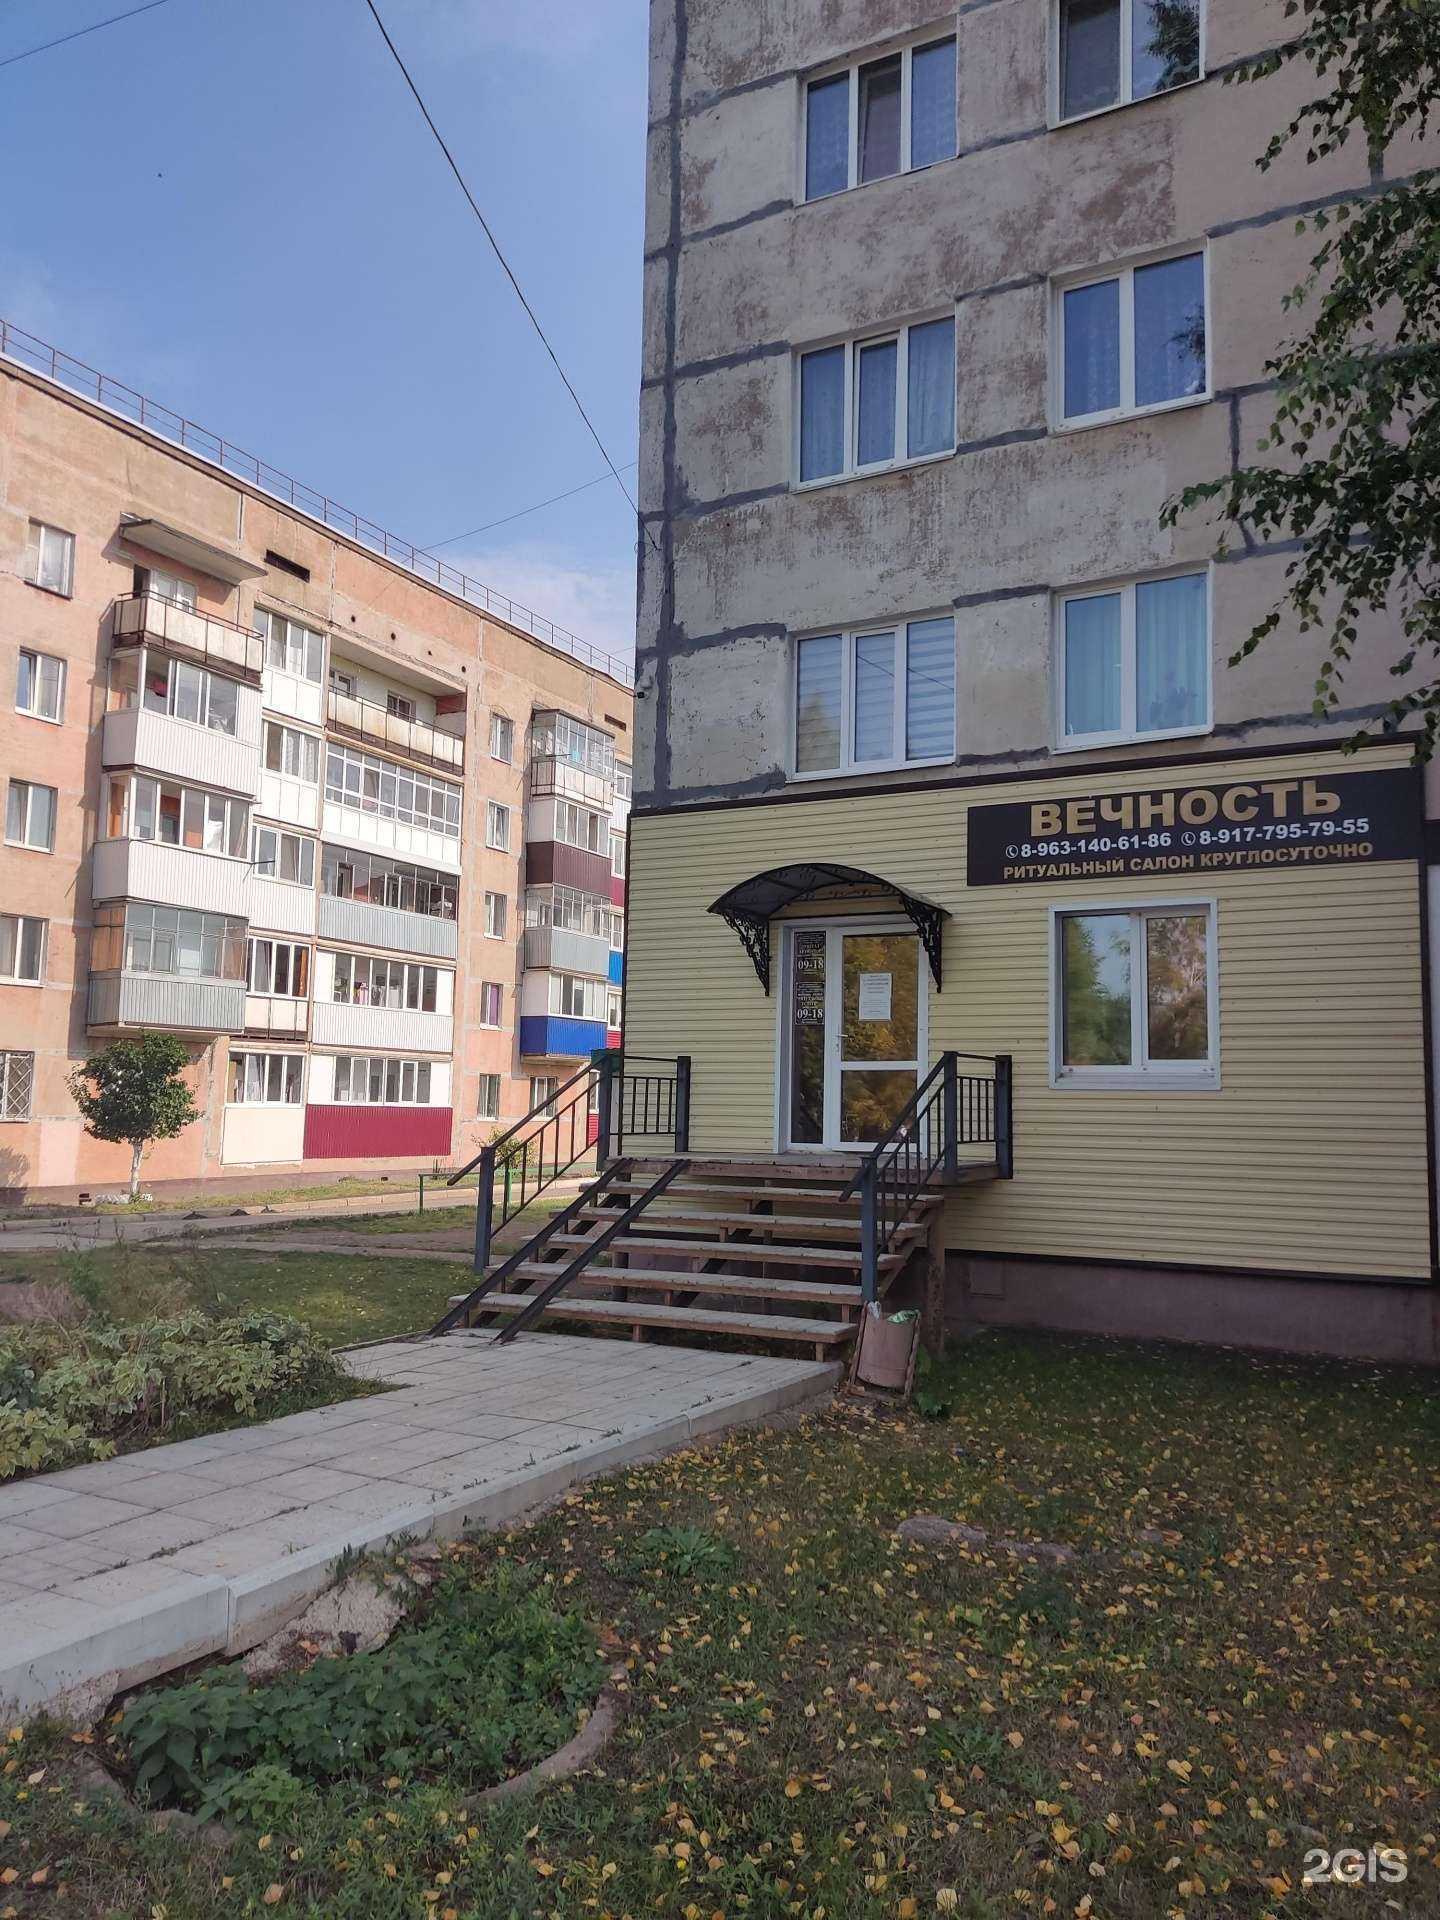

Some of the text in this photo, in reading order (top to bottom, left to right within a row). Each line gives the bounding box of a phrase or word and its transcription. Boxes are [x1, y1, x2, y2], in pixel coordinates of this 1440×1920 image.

[1031, 780, 1341, 837] ВЕЧНОСТЬ
[1021, 818, 1369, 858] 8-963-140-61-86 8-917-795-79-55
[1003, 842, 1374, 879] РИТУАЛЬНЫЙ САЛОН КРУГЛОСУТОЧНО
[798, 960, 824, 970] 09-18
[797, 1008, 823, 1019] 09-18
